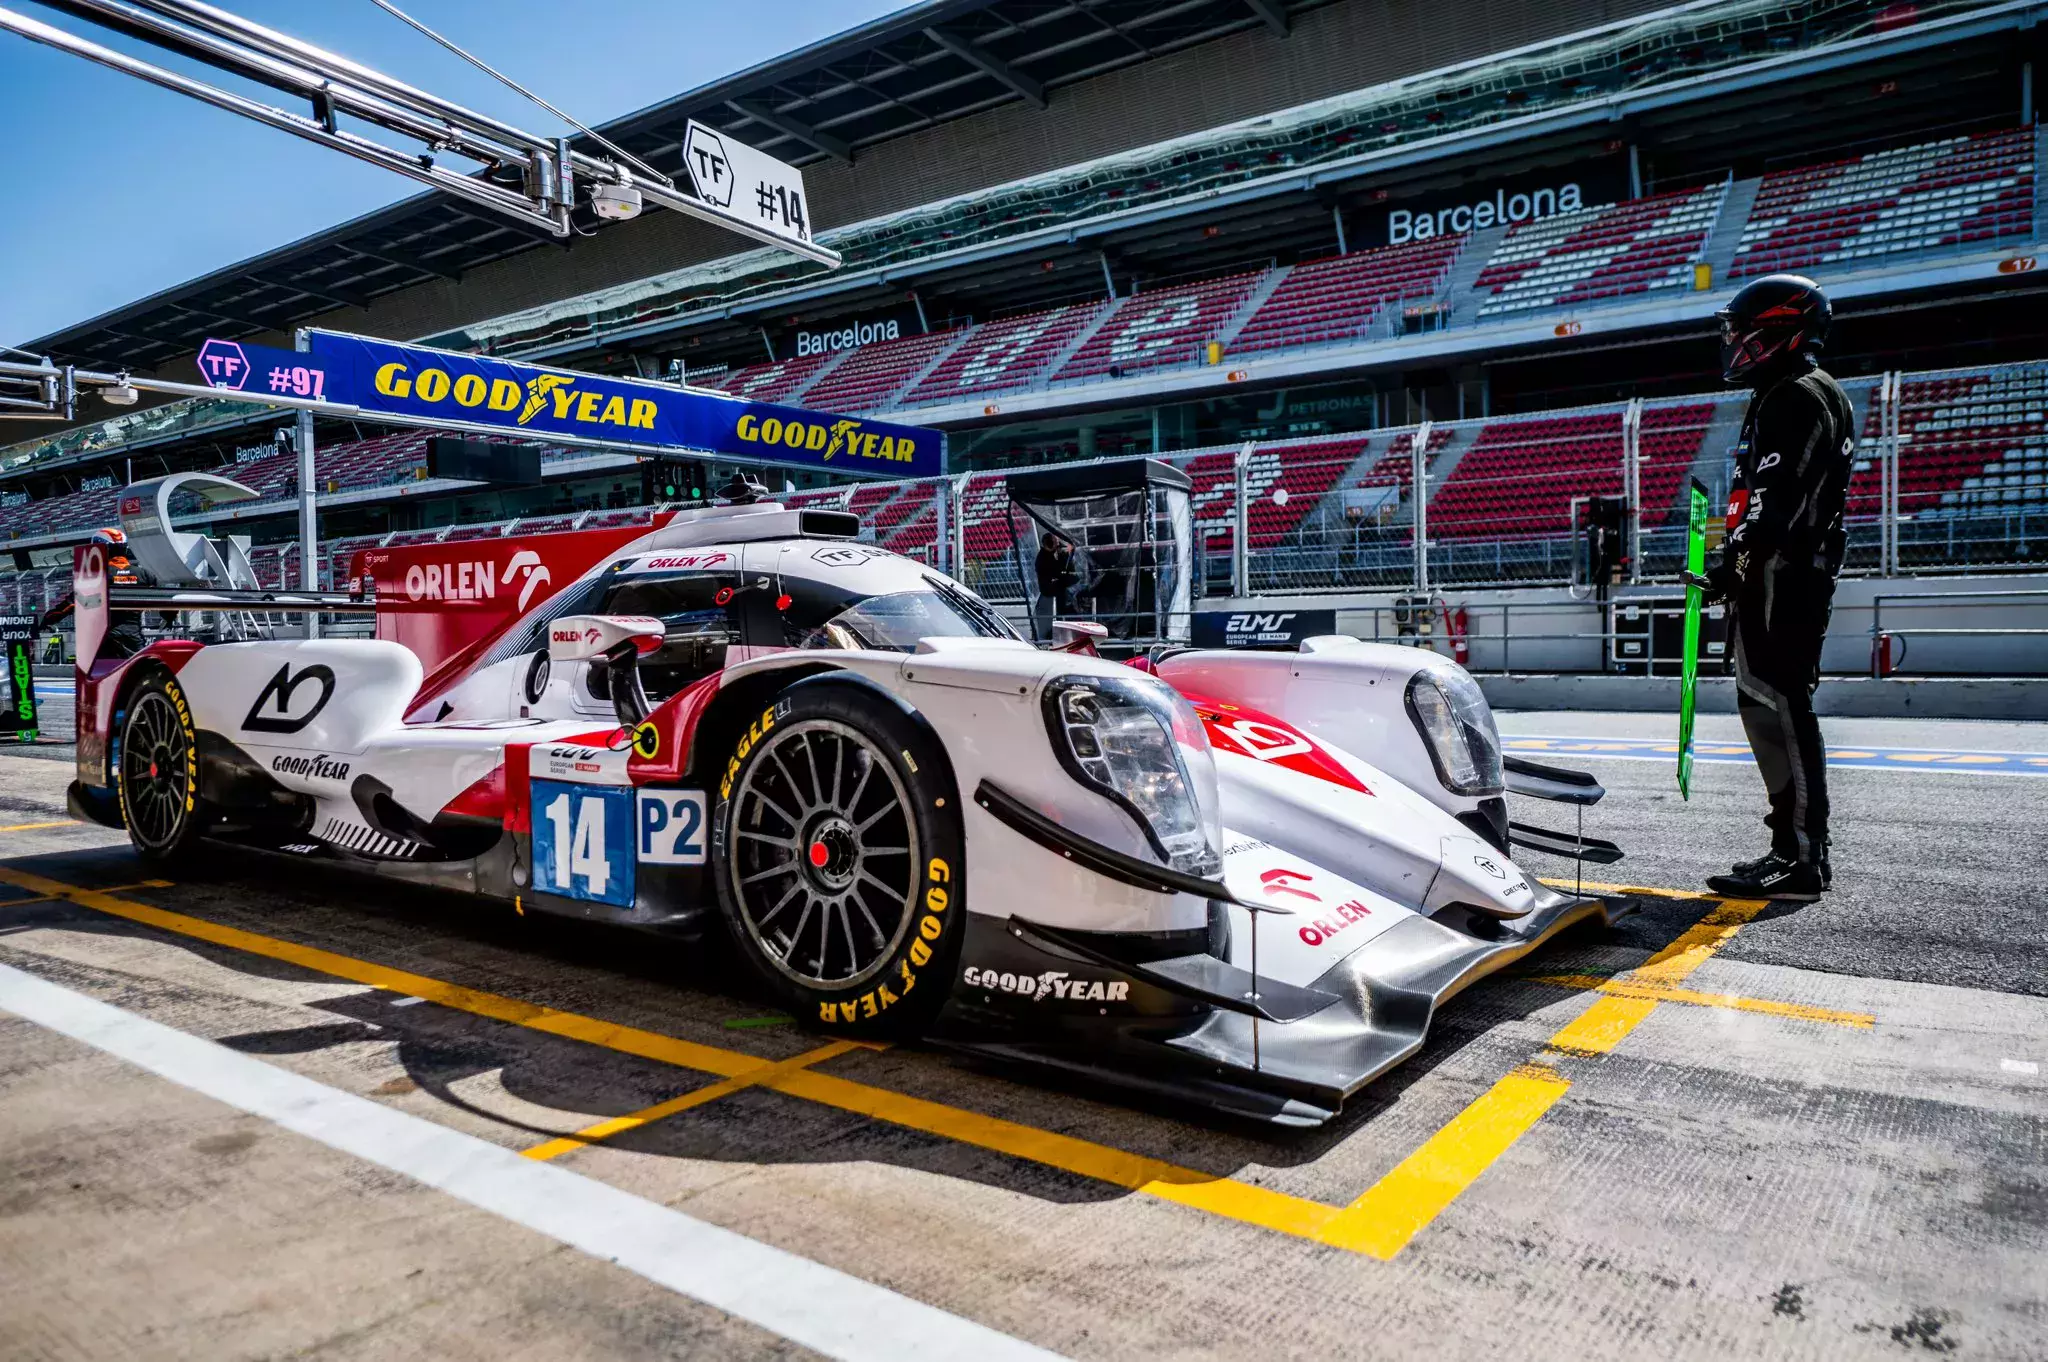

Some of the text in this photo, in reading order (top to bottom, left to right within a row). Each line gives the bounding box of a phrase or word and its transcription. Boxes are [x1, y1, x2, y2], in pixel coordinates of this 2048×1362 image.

[693, 146, 724, 183] TF
[1389, 183, 1583, 244] Barcelona
[2012, 258, 2033, 271] 17
[797, 319, 900, 357] Barcelona
[206, 355, 241, 377] TF
[268, 367, 325, 397] #97
[236, 443, 279, 464] Barcelona
[81, 474, 112, 492] Barcelona
[373, 555, 389, 563] SPORT
[648, 557, 700, 569] ORLEN
[820, 550, 853, 562] TF
[406, 561, 495, 601] ORLEN
[2, 631, 32, 640] YOUR
[553, 631, 582, 642] ORLEN
[14, 644, 33, 720] START
[721, 707, 776, 800] EAGLE
[641, 798, 702, 855] P2
[545, 793, 610, 895] 14
[1480, 861, 1497, 873] TF
[1299, 900, 1372, 946] ORLEN
